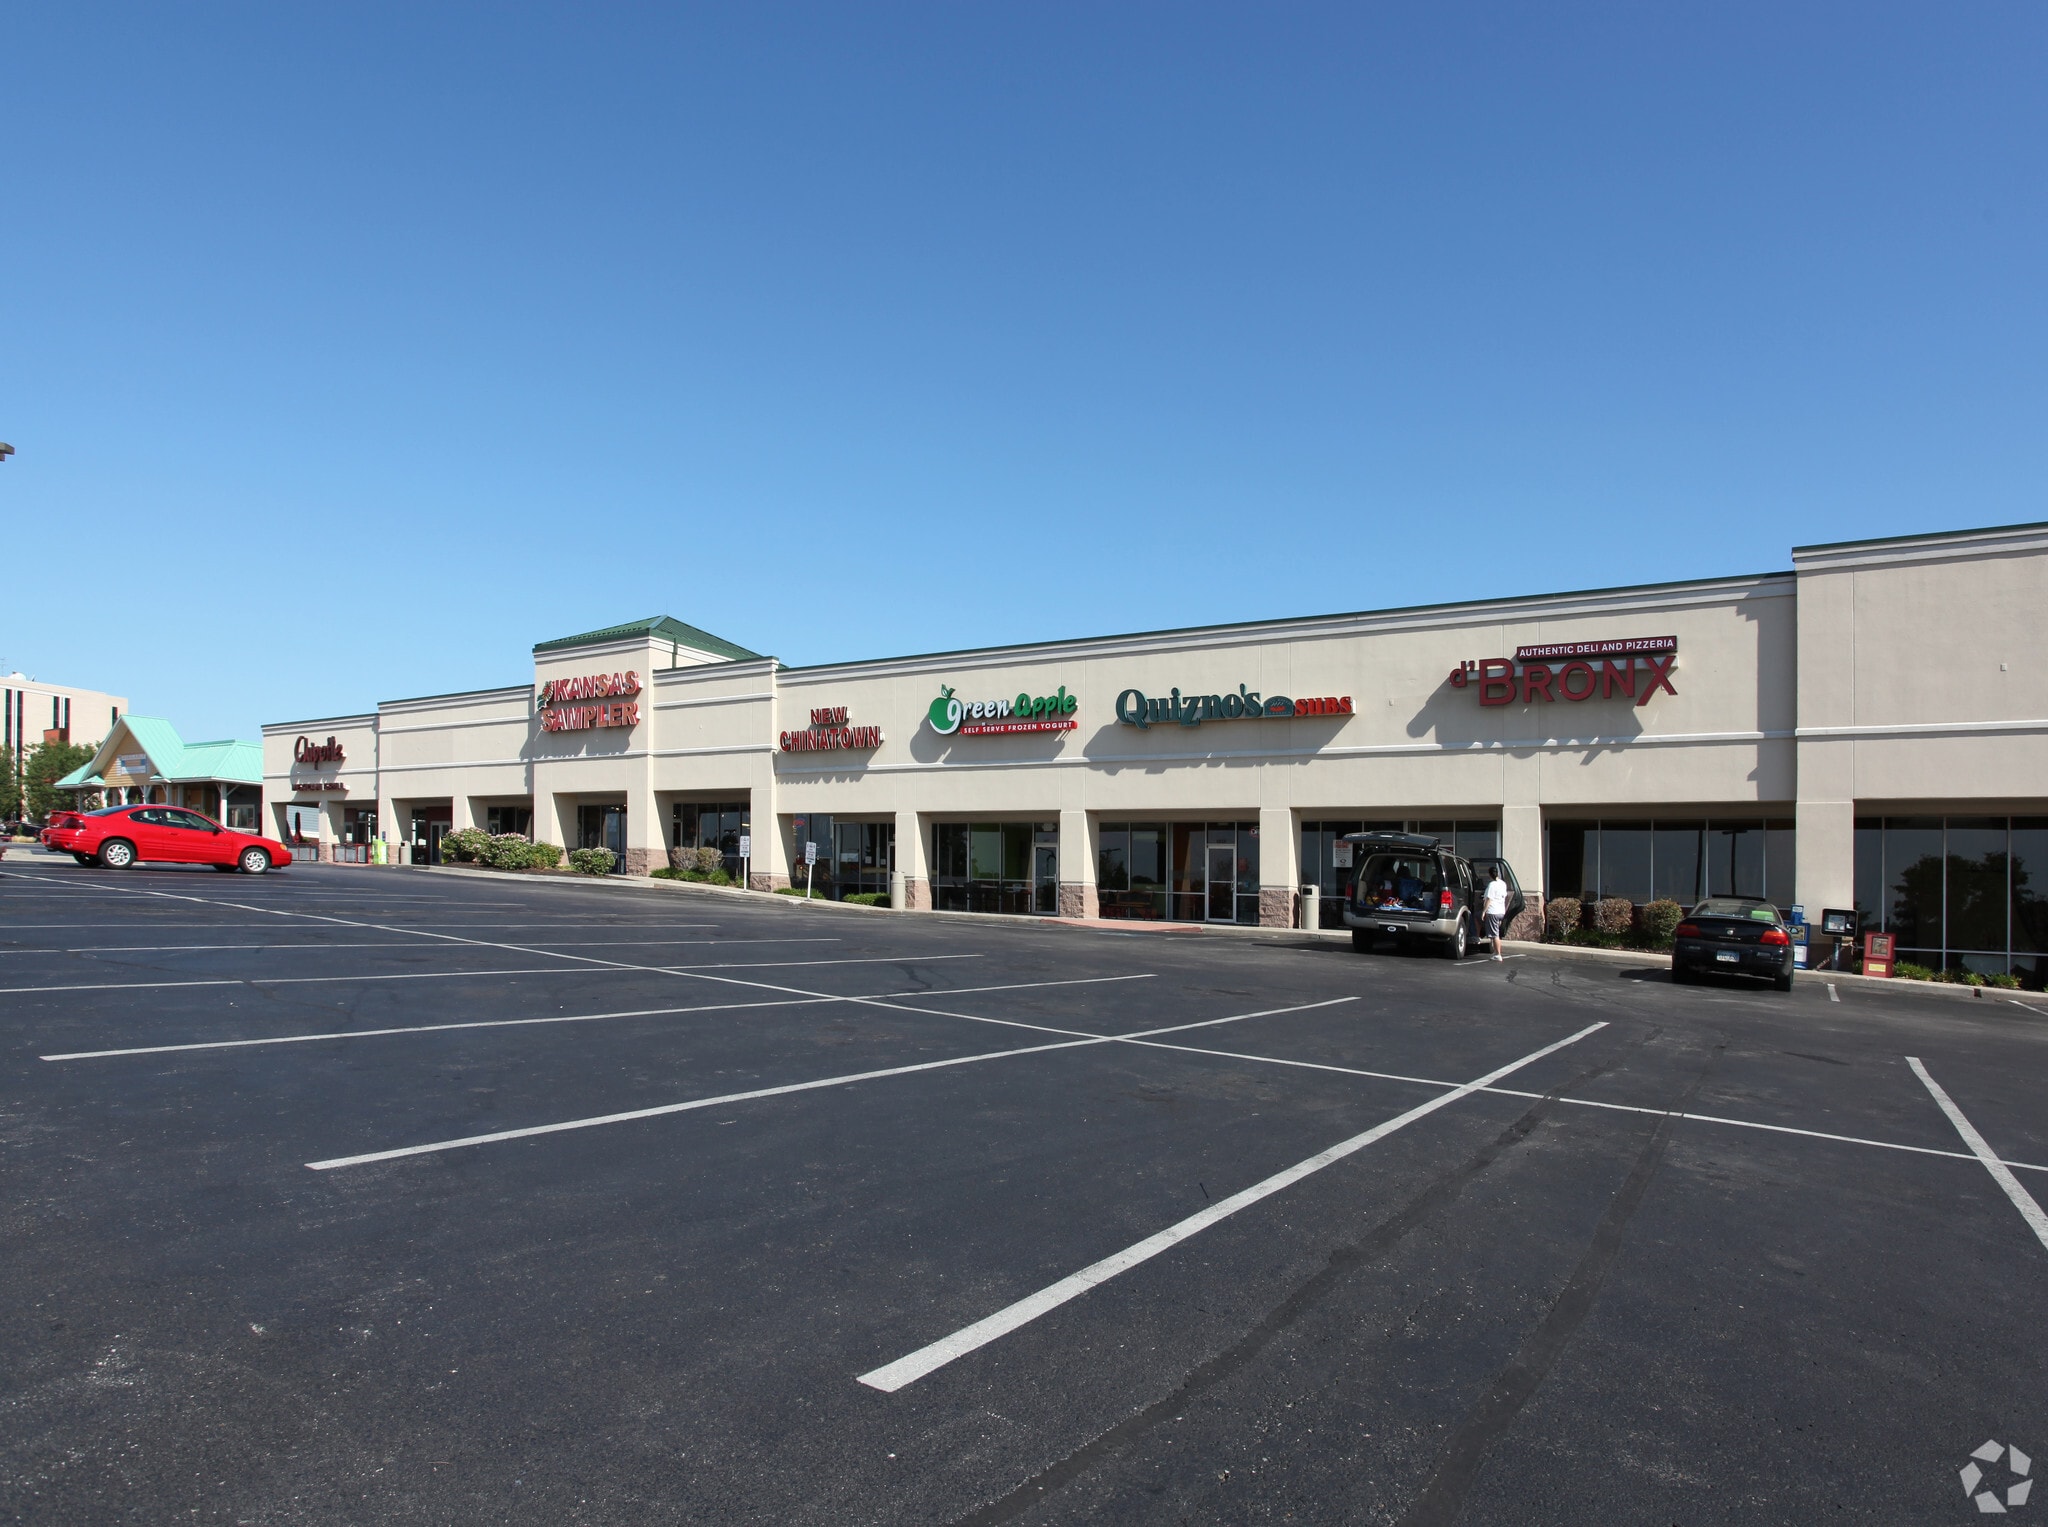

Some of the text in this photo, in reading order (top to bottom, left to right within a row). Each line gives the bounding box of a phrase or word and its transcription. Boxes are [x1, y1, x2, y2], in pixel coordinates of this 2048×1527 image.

[1519, 639, 1674, 657] AUTHENTIC DELI AND PIZZERIA
[553, 670, 640, 702] KANSAS
[541, 702, 639, 732] SAMPLER
[810, 706, 848, 725] NEW
[1115, 683, 1263, 730] Quizno's
[780, 725, 881, 752] CHINATOWN
[963, 721, 1073, 734] SELF SERVE FROZEN YOGURT
